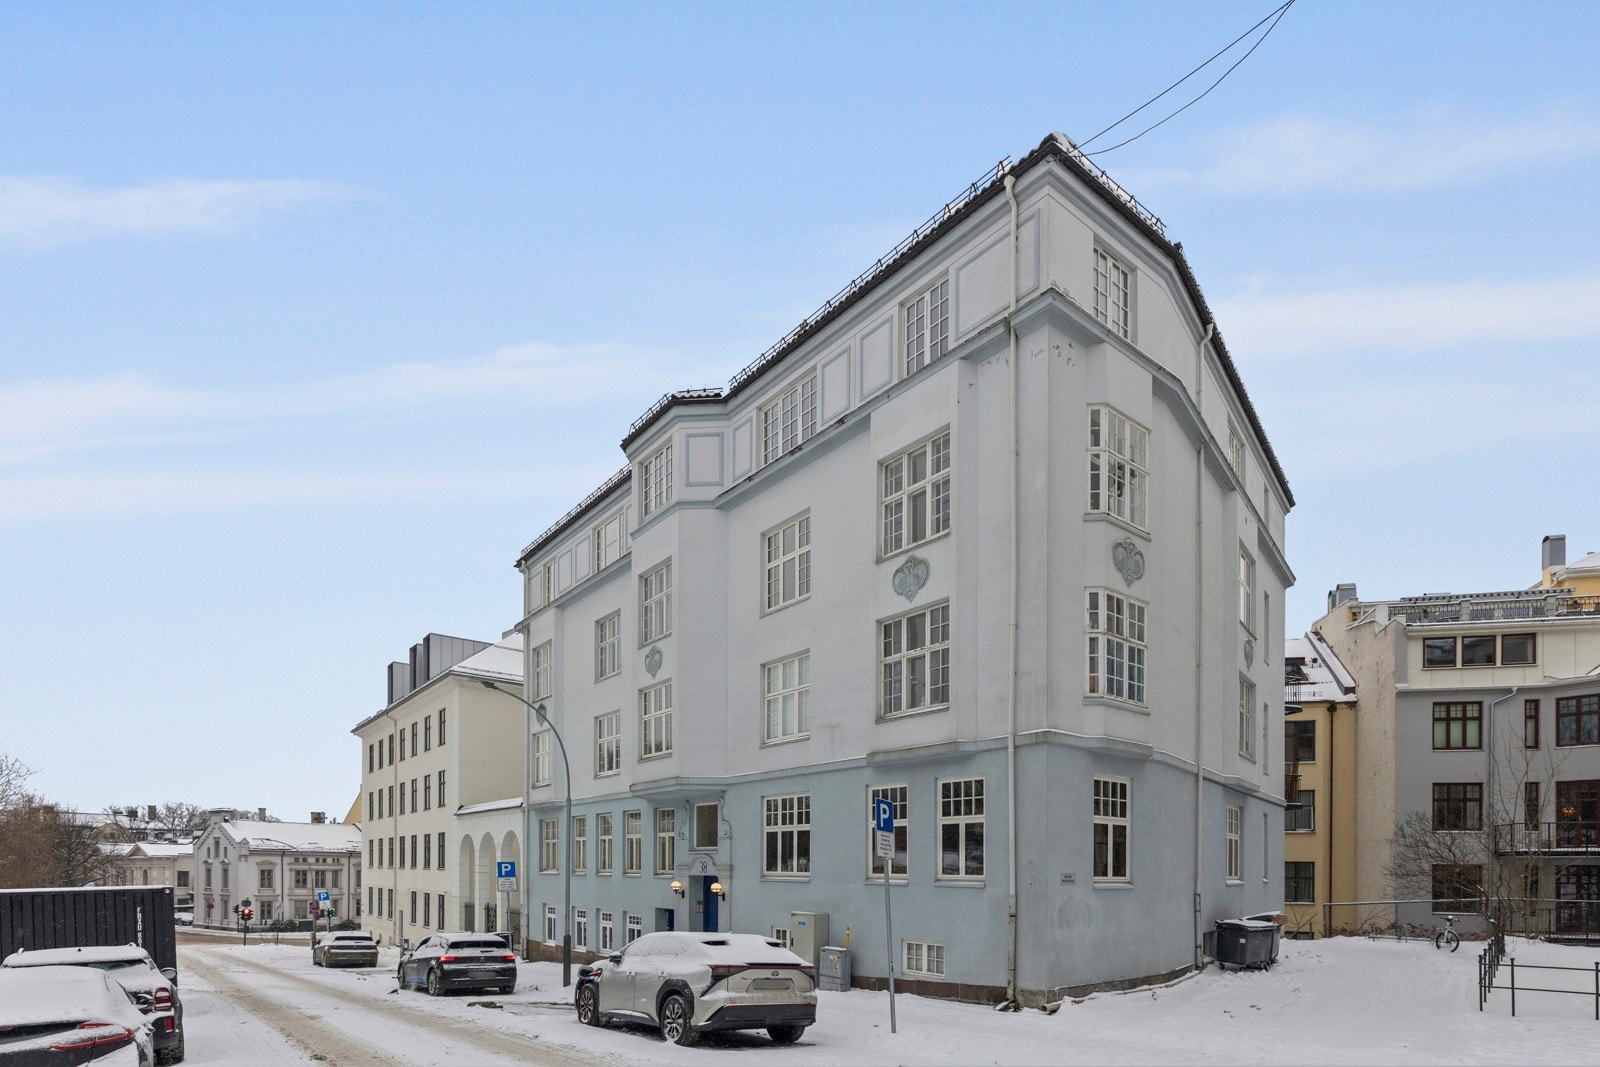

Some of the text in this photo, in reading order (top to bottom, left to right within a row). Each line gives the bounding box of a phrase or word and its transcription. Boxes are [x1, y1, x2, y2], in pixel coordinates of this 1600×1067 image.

[880, 803, 889, 827] P
[502, 864, 511, 875] P
[700, 860, 707, 873] 38
